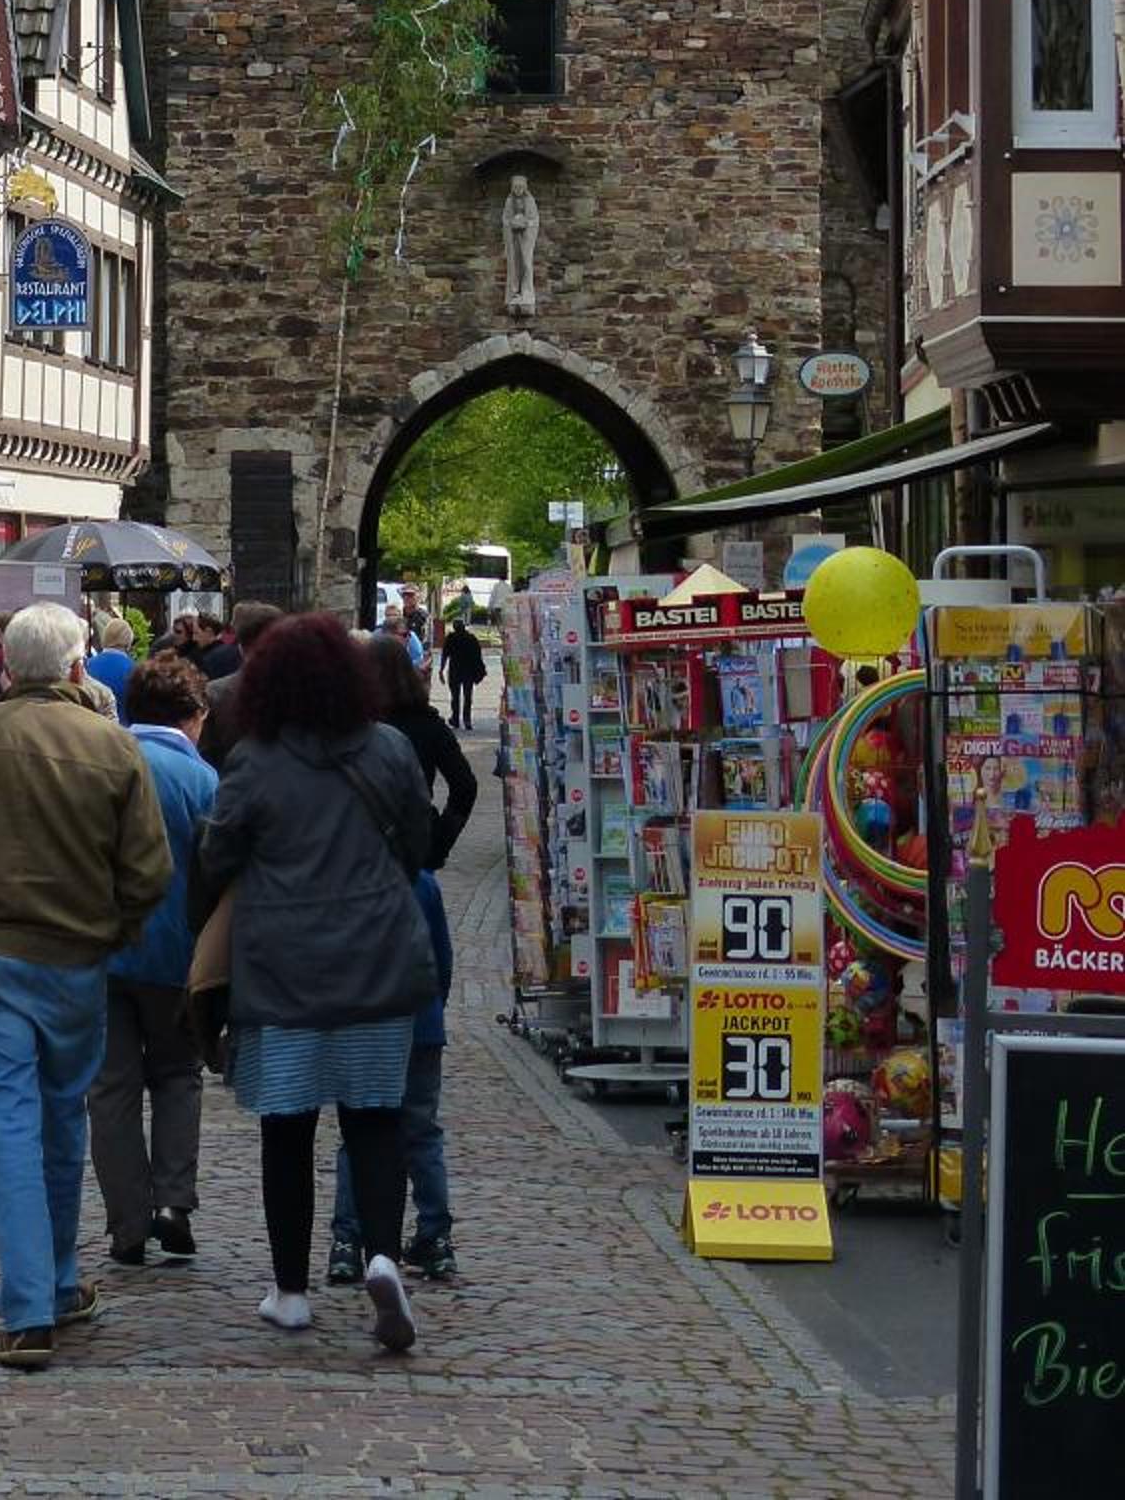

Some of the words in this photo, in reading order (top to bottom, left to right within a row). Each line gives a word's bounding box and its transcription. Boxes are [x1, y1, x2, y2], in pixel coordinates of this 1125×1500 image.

[16, 281, 86, 296] RESTAURANT
[16, 300, 86, 325] DELPHI
[635, 606, 718, 628] BASTEI
[725, 820, 786, 847] EURO
[703, 843, 812, 875] JACKPOT
[778, 879, 816, 893] Freitag
[724, 897, 791, 959] 90
[723, 992, 786, 1010] LOTTO
[723, 1015, 791, 1031] JACKPOT
[726, 1037, 790, 1099] 30
[736, 1203, 818, 1221] LOTTO
